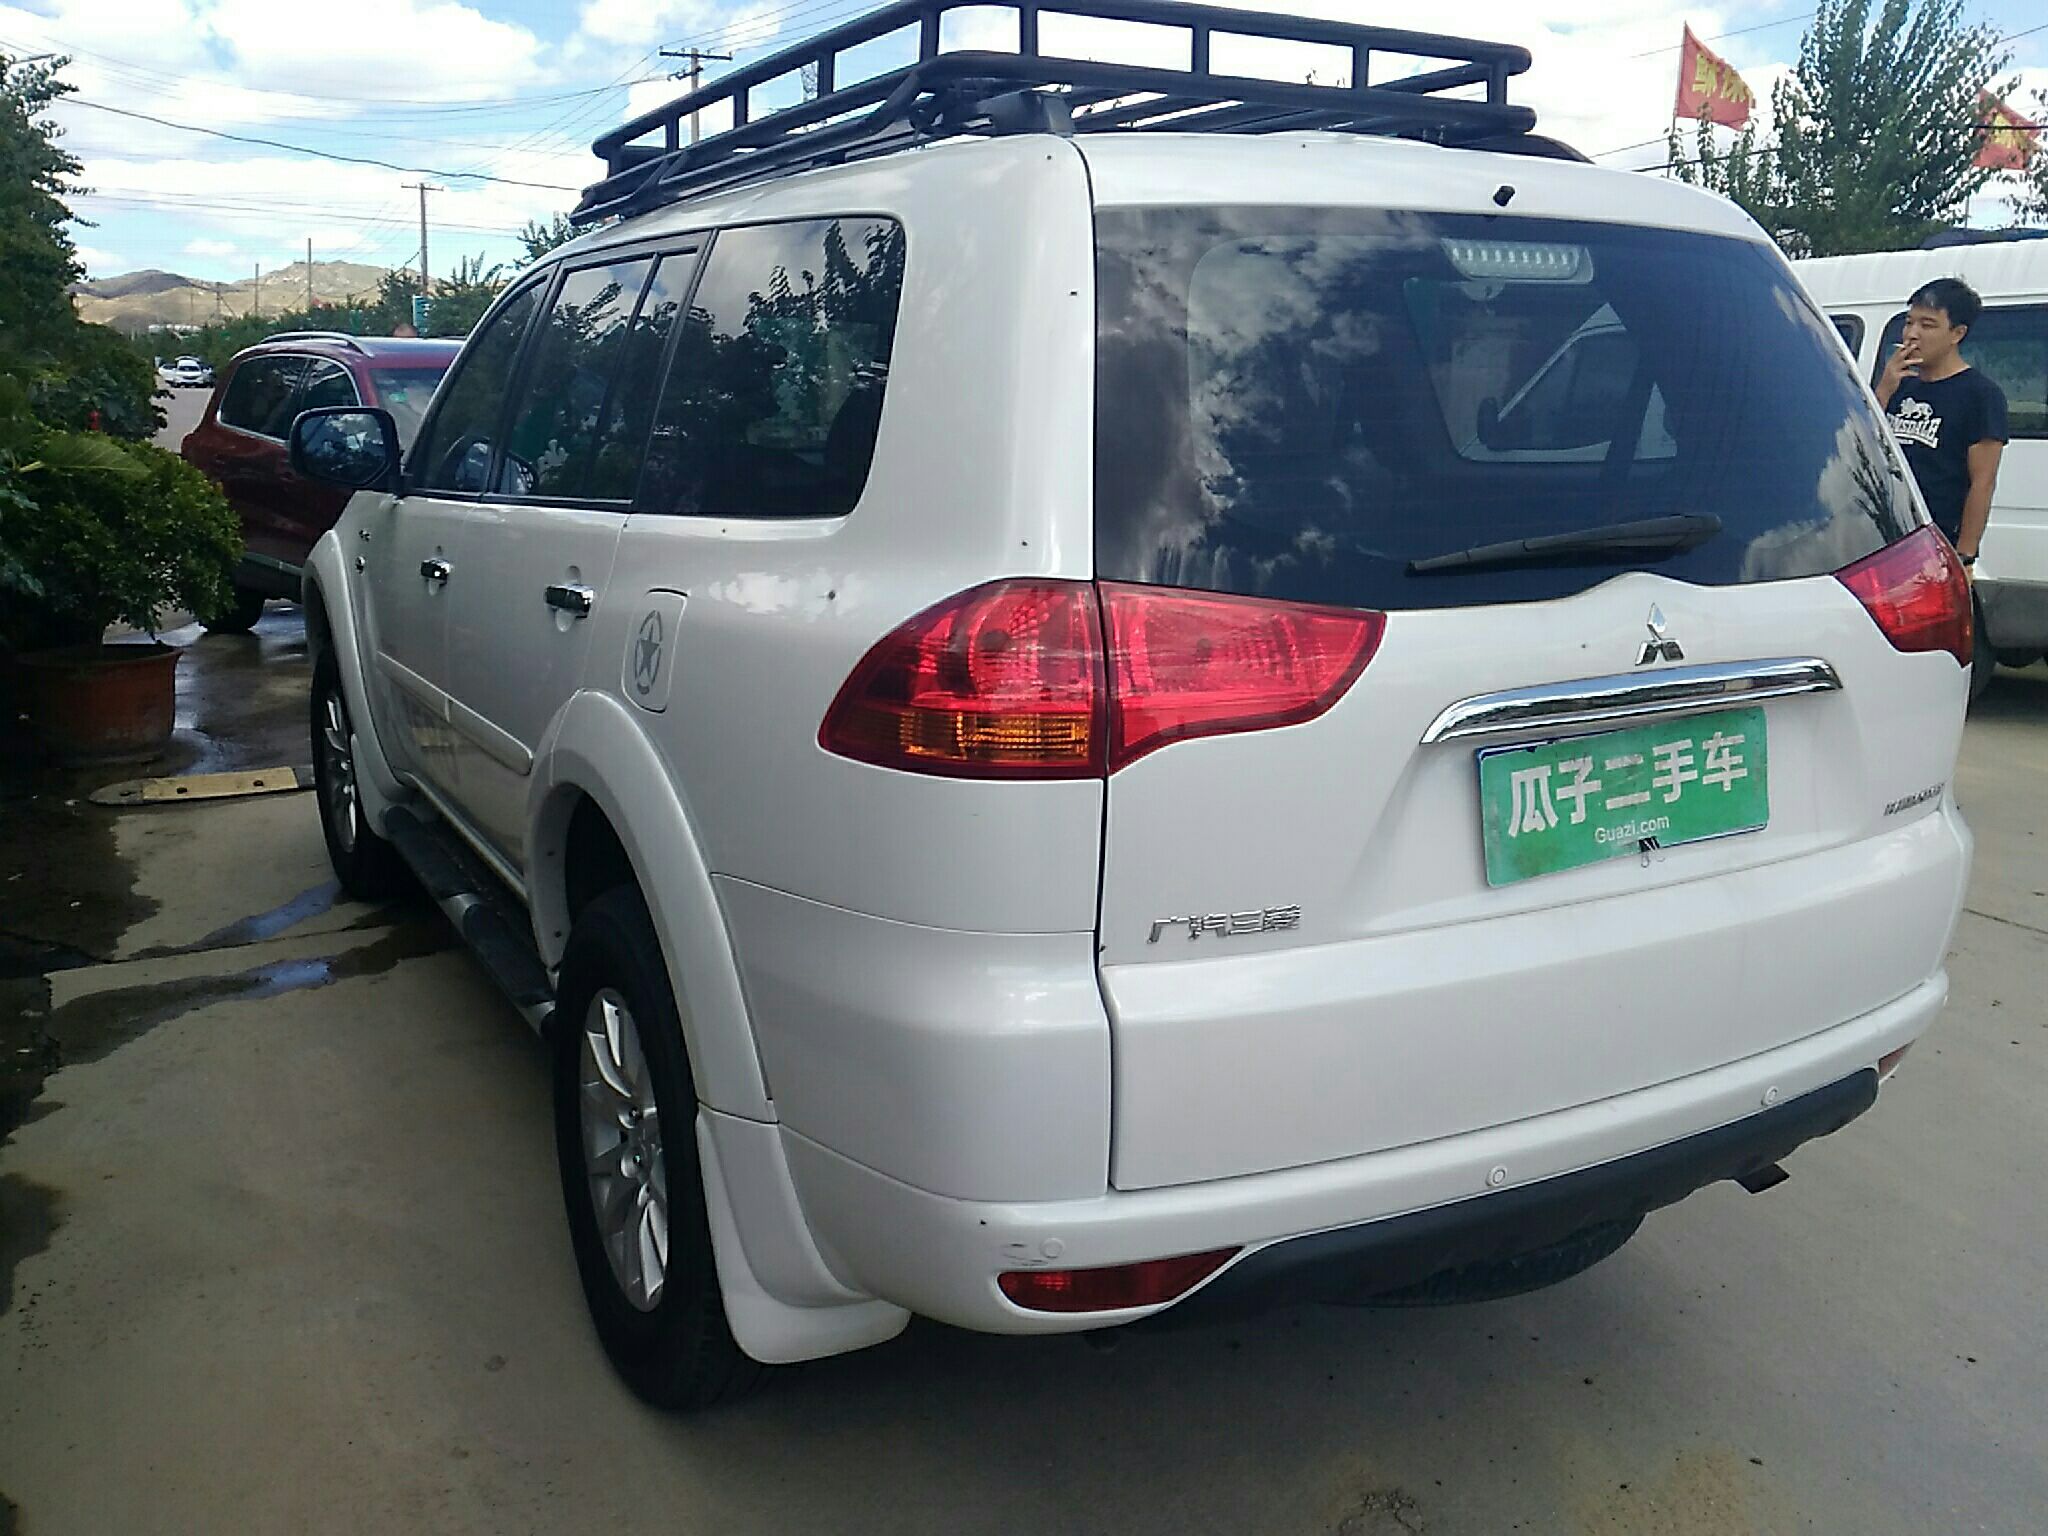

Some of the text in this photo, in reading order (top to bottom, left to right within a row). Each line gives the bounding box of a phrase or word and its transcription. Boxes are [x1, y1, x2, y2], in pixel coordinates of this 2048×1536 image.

[1508, 731, 1748, 838] 瓜子二手车
[1594, 816, 1670, 844] Guazi.com
